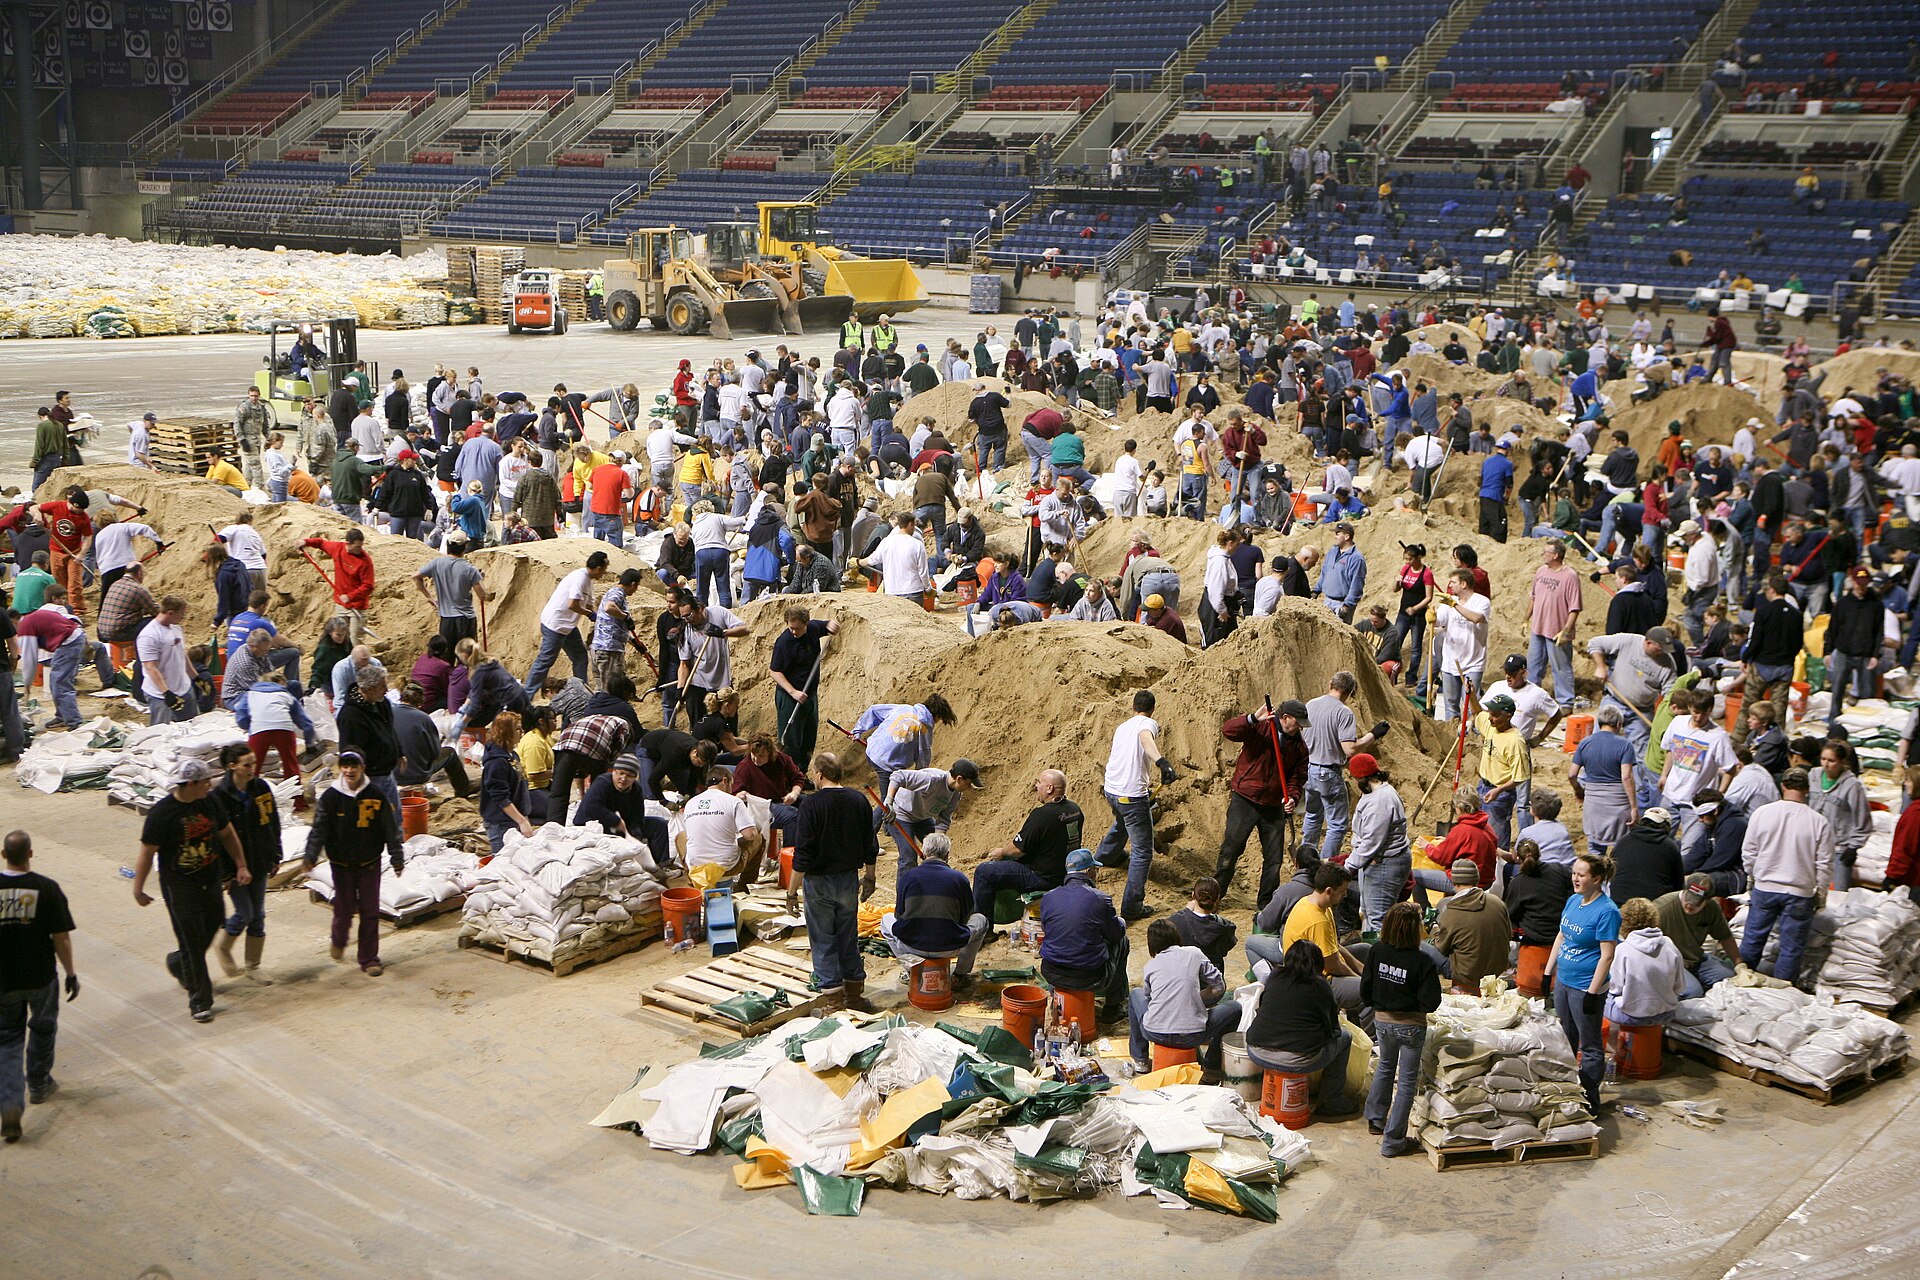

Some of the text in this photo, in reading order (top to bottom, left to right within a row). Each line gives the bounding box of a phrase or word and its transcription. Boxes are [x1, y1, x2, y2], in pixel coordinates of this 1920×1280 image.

[614, 271, 634, 279] FORD
[255, 792, 273, 826] F
[357, 798, 382, 828] F
[1378, 962, 1408, 979] DMI
